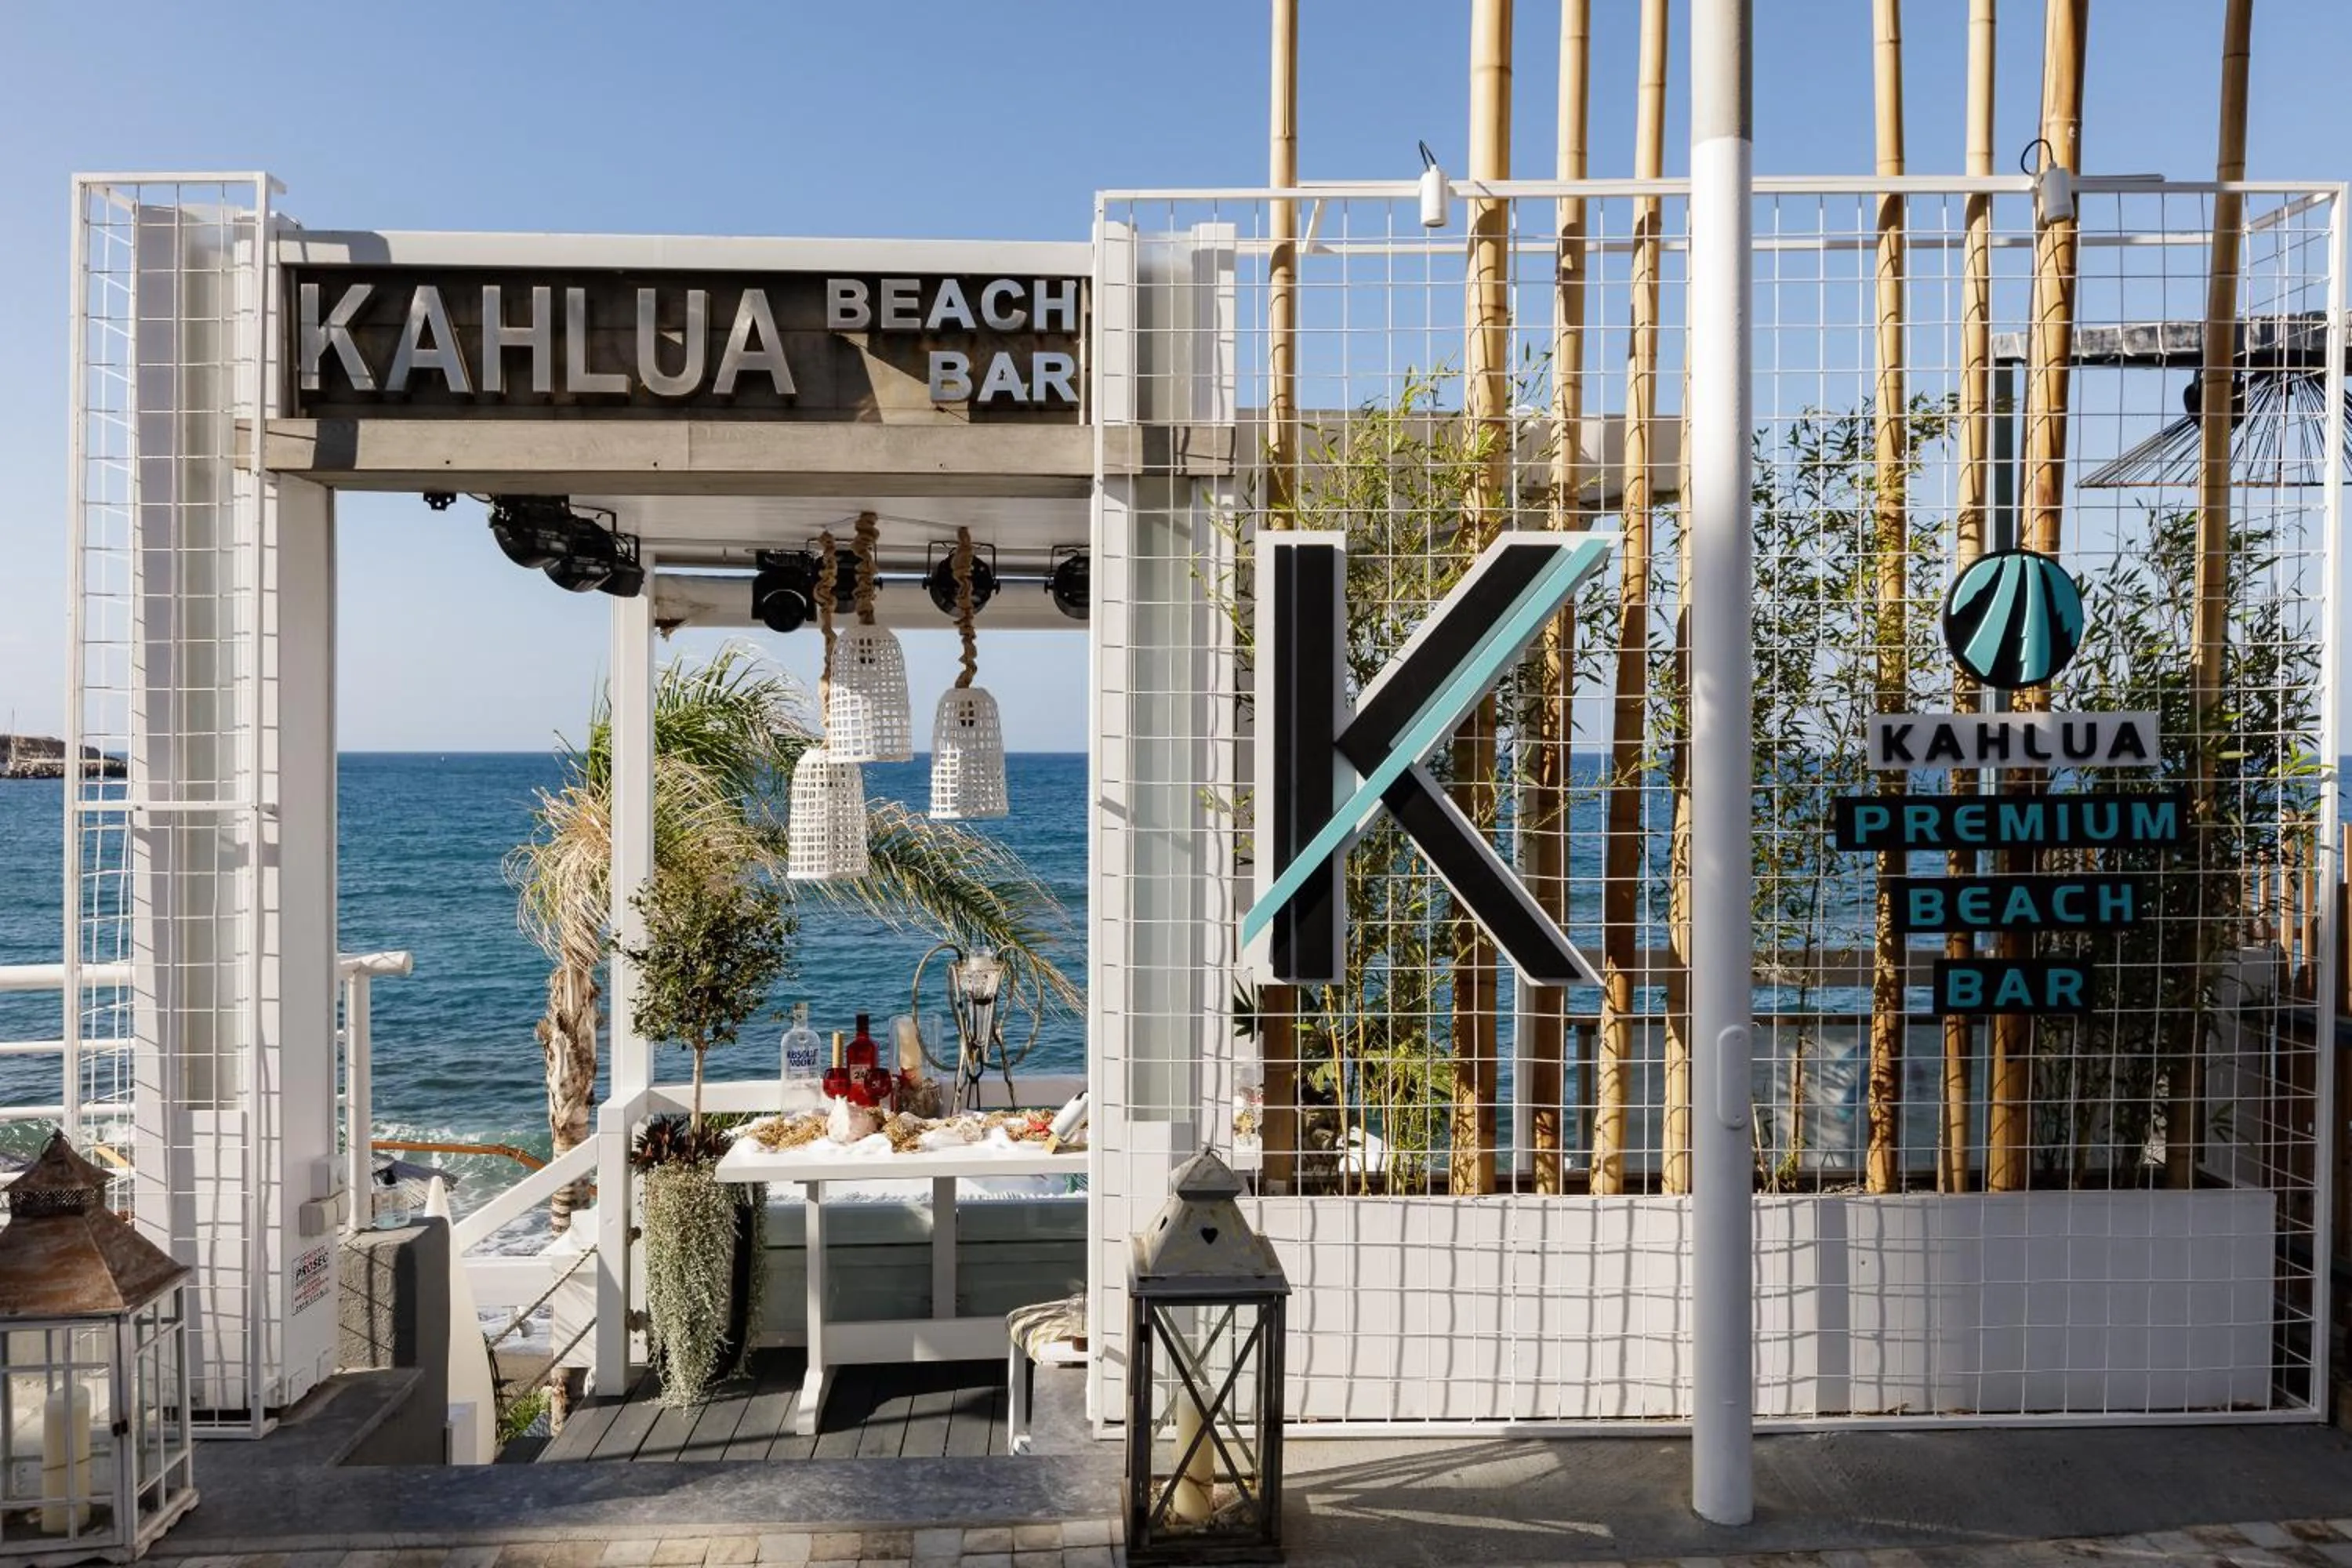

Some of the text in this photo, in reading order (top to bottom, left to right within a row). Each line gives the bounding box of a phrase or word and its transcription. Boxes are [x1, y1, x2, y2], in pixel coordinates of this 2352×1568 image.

[827, 278, 1077, 332] BEACH
[300, 283, 797, 395] KAHLUA
[929, 350, 1080, 402] BAR
[1243, 531, 1619, 985] K
[1882, 721, 2147, 762] KAHLUA
[1854, 802, 2176, 844] PREMIUM
[1908, 883, 2134, 927] BEACH
[1946, 967, 2083, 1008] BAR
